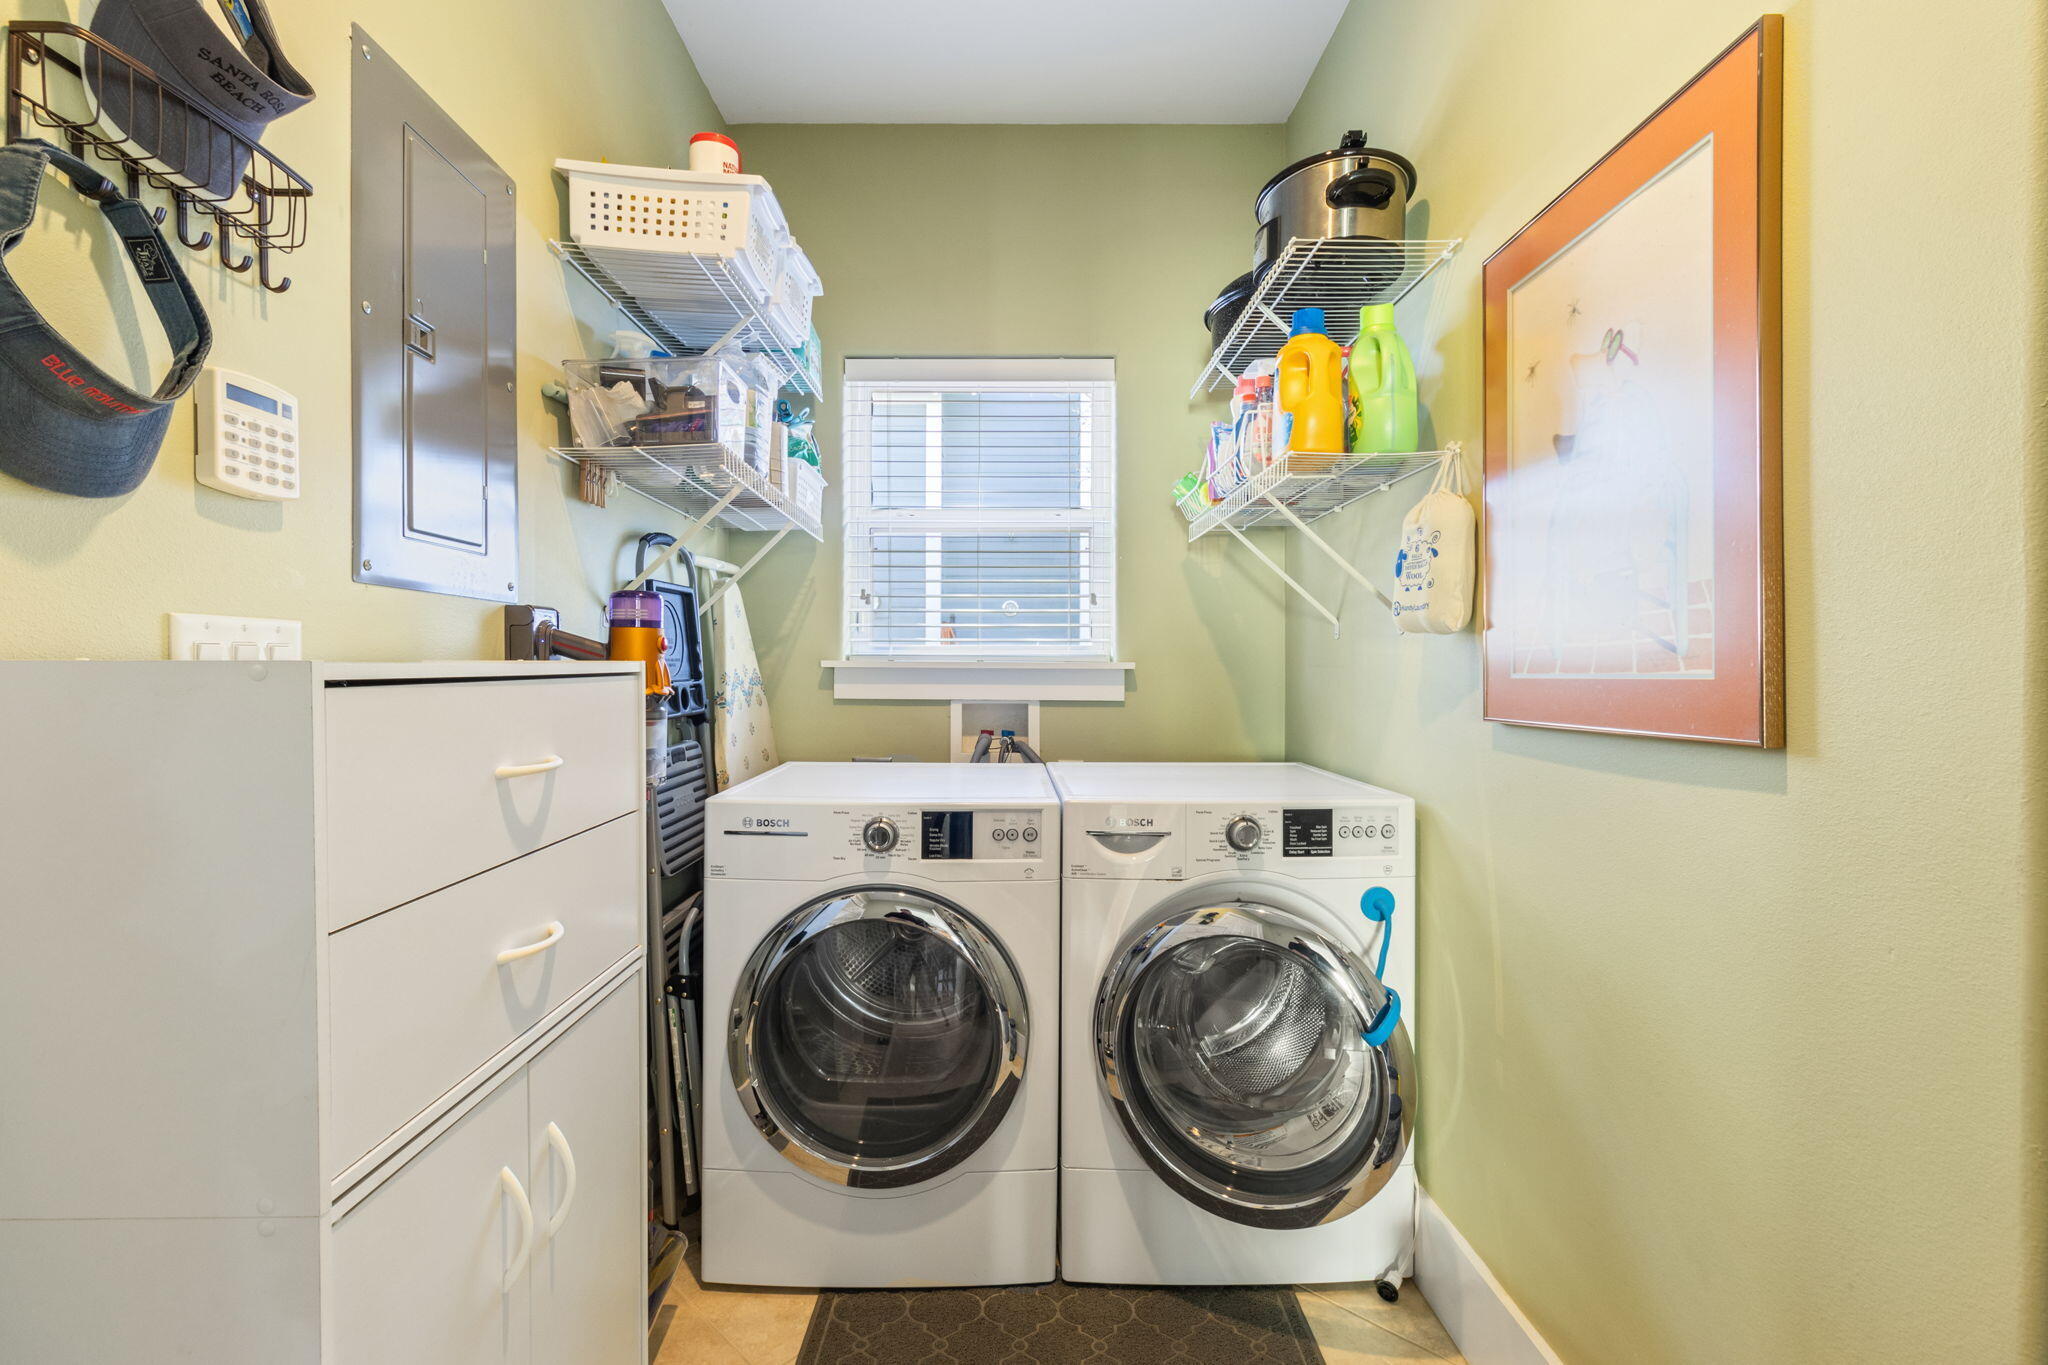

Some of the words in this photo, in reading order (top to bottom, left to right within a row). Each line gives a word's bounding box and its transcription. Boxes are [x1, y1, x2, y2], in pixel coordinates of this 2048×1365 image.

[197, 47, 259, 92] SANTA
[209, 71, 267, 114] BEACH
[756, 818, 790, 828] BOSCH
[1119, 818, 1154, 827] BOSCH
